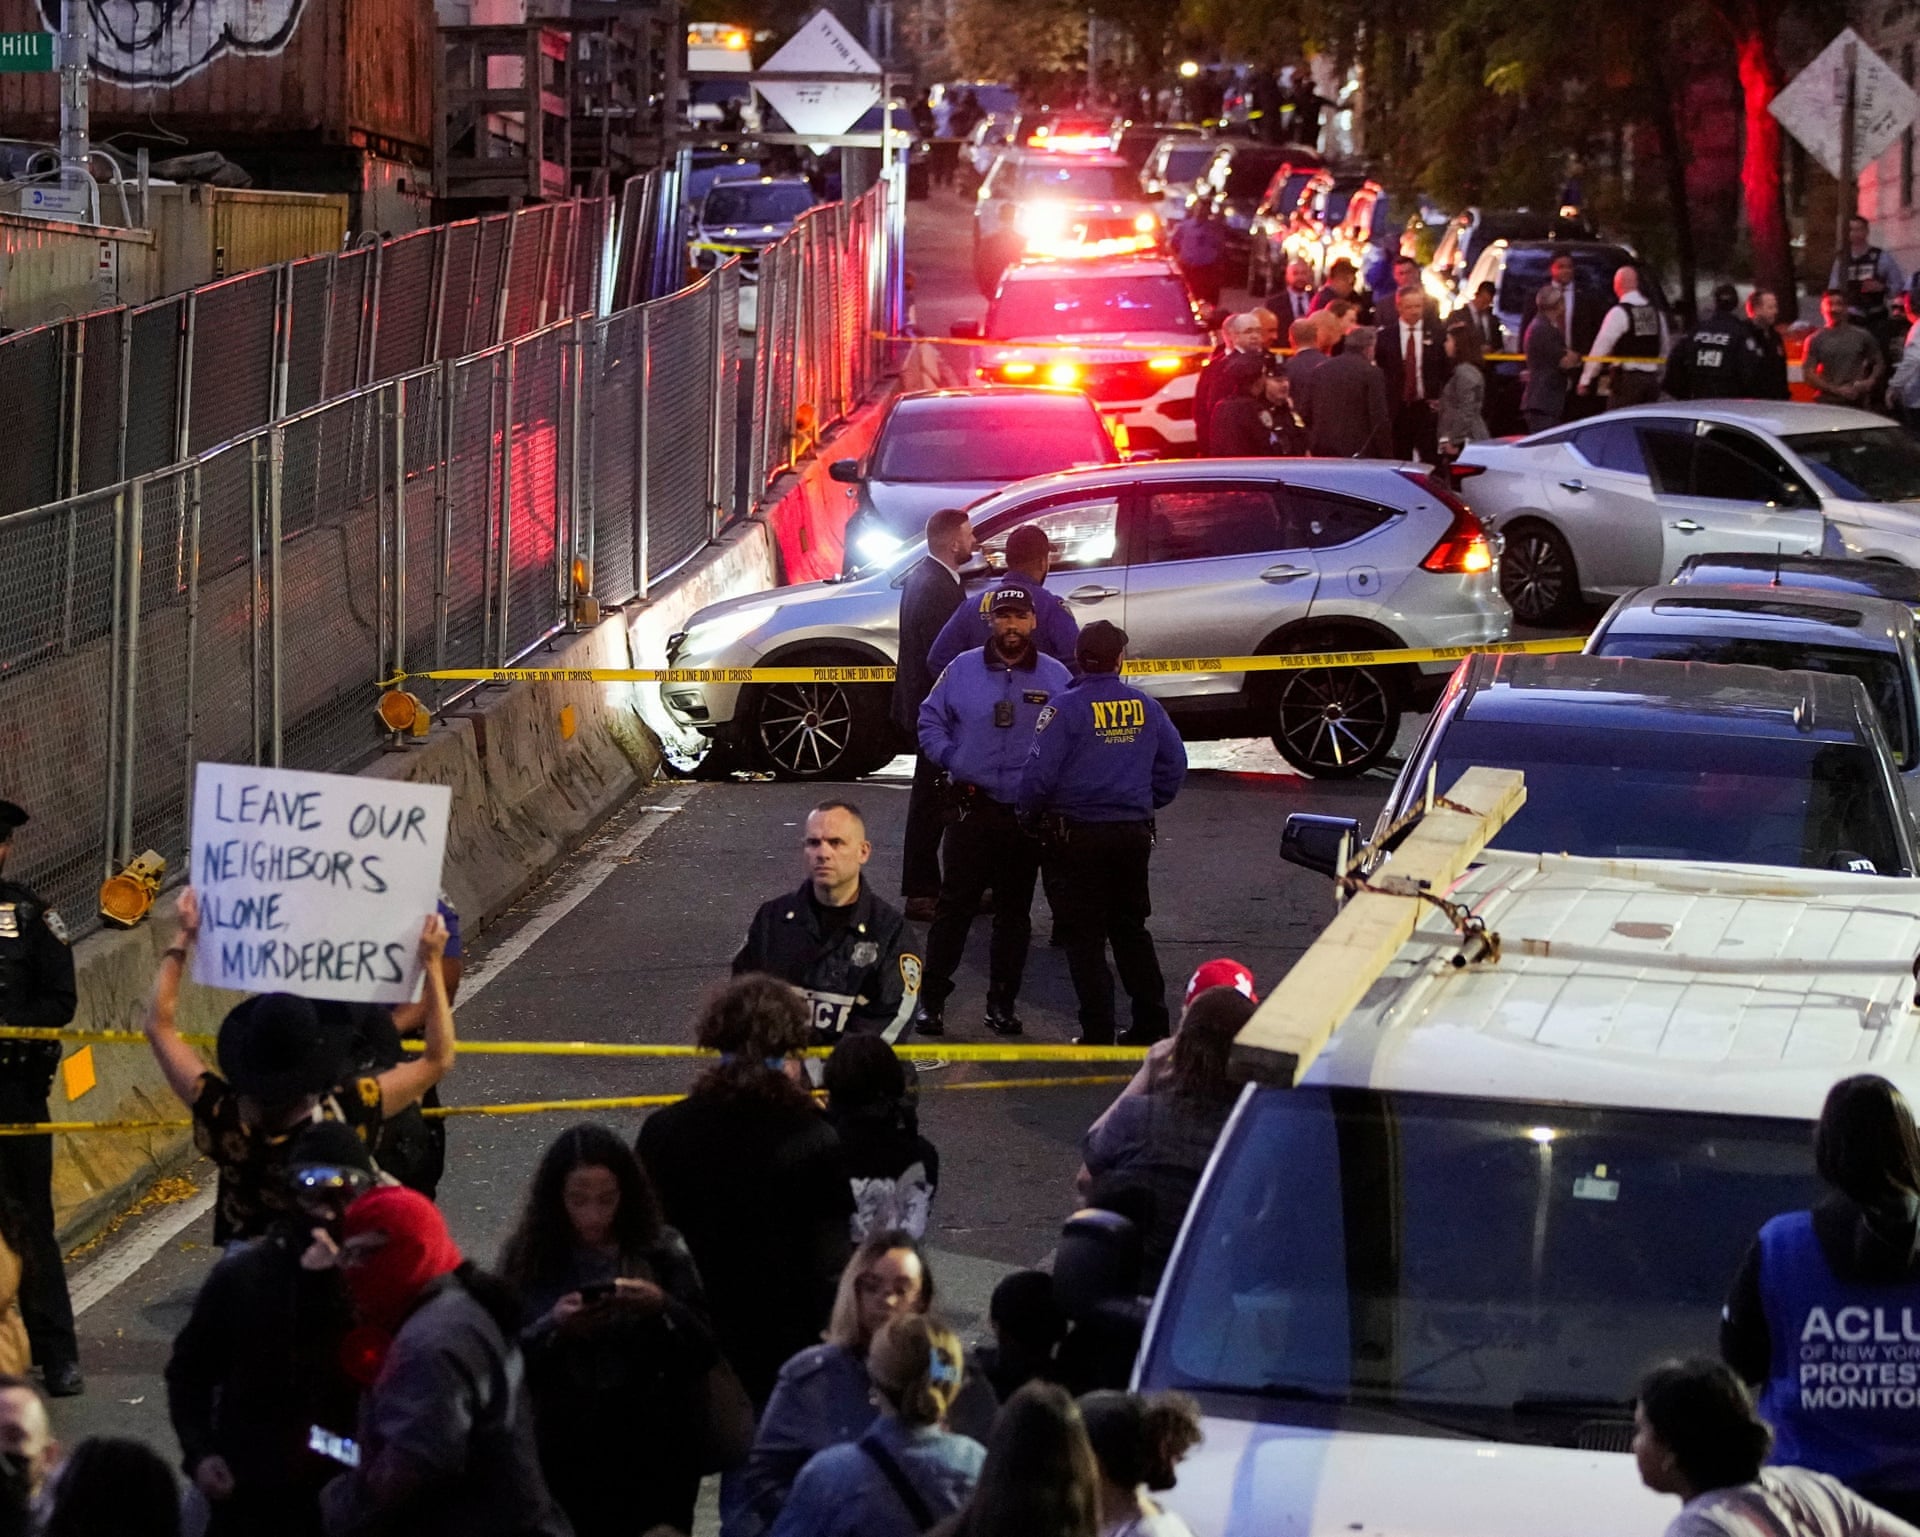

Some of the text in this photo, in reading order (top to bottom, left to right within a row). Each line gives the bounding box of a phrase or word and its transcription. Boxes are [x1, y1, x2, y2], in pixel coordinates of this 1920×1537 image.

[2, 34, 39, 56] Hill
[997, 590, 1025, 600] NYPD
[493, 671, 593, 681] POLICE LINE DO NOT CROSS
[654, 669, 753, 681] POLICE LINE DO NOT CROSS
[813, 668, 840, 680] POLICE
[841, 668, 857, 680] LINE
[858, 668, 869, 680] DO
[870, 668, 884, 680] NOT
[1126, 659, 1222, 673] POLICE LINE DO NOT CROSS
[1091, 699, 1145, 729] NYPD
[1095, 727, 1142, 737] COMMUNITY
[215, 783, 427, 844] LEAVE OUR
[203, 840, 387, 893] NEIGHBORS
[222, 939, 405, 984] MURDERERS
[1800, 1306, 1920, 1342] ACLU
[1800, 1344, 1826, 1360] OF
[1831, 1344, 1877, 1360] NEW
[1800, 1362, 1920, 1386] PROTES
[1800, 1385, 1920, 1411] MONITO
